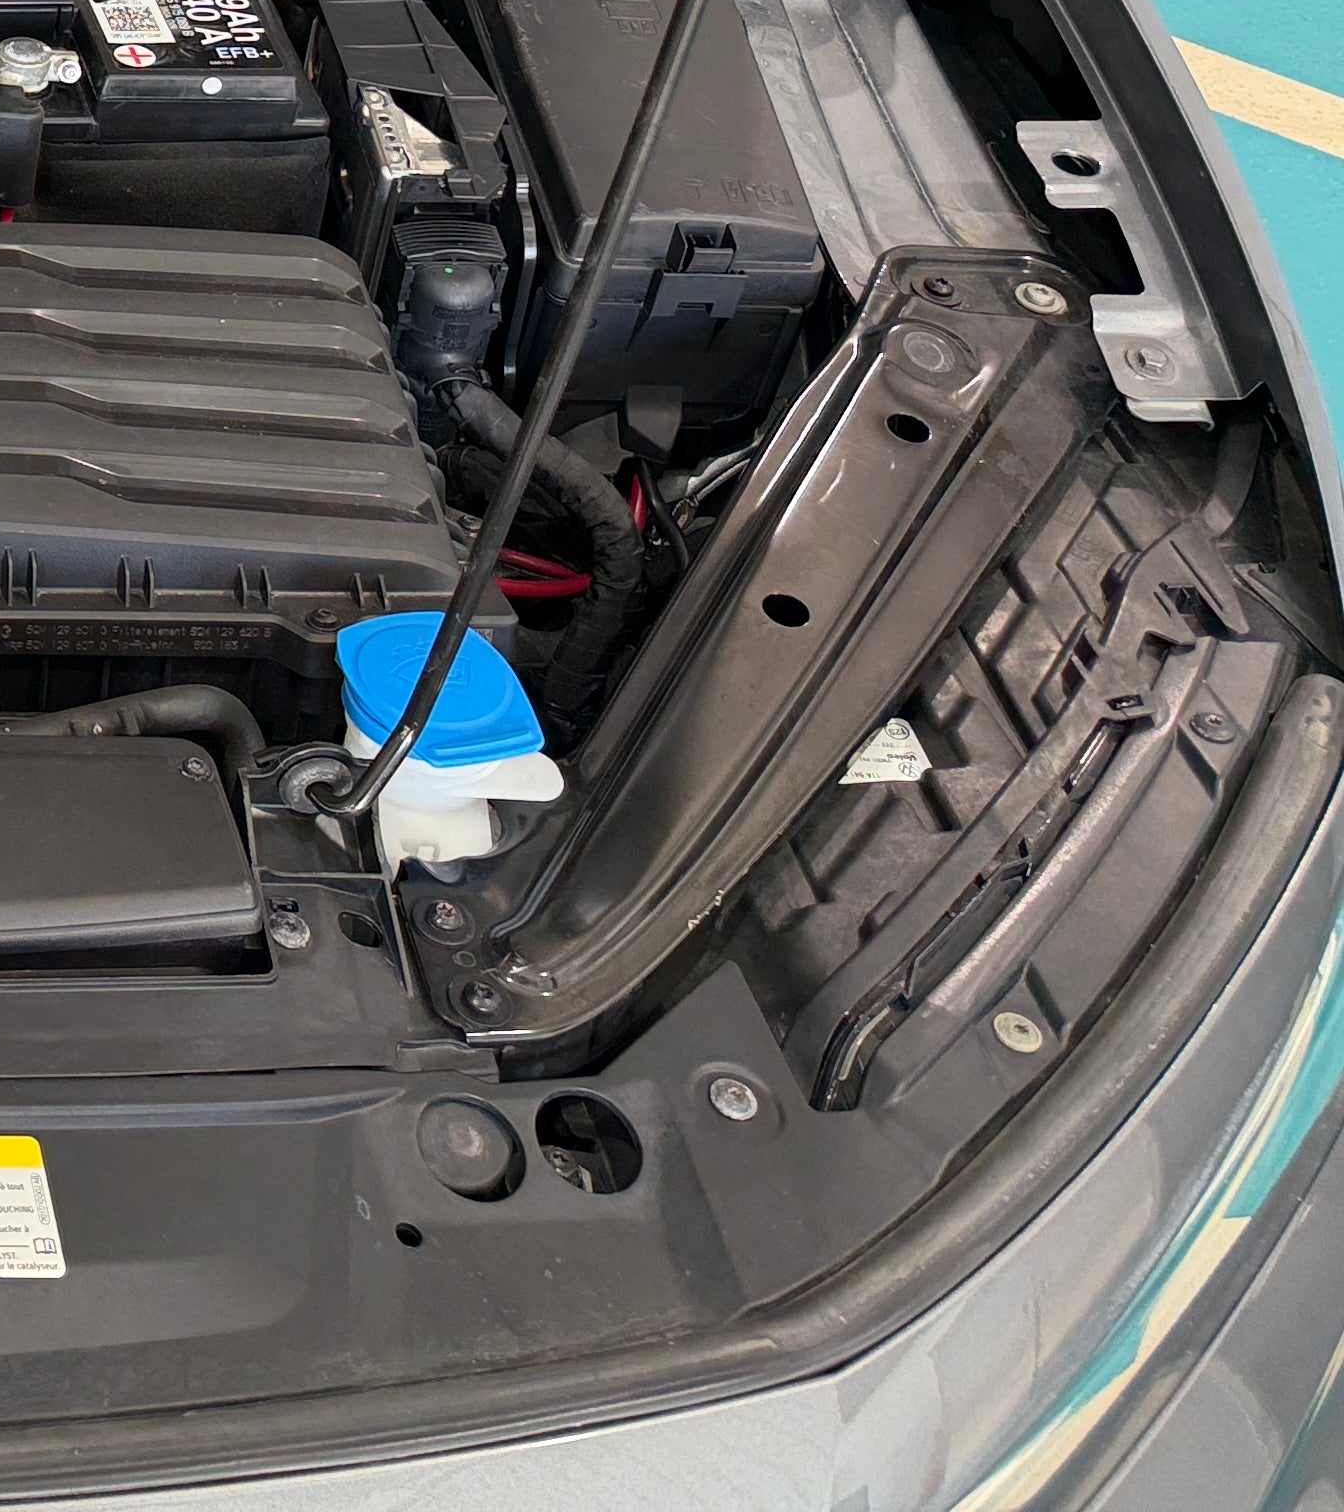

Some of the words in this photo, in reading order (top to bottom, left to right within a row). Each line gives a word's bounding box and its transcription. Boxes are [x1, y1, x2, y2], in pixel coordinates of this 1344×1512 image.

[194, 26, 233, 46] A
[215, 46, 274, 60] EFB+
[7, 1183, 24, 1191] tout
